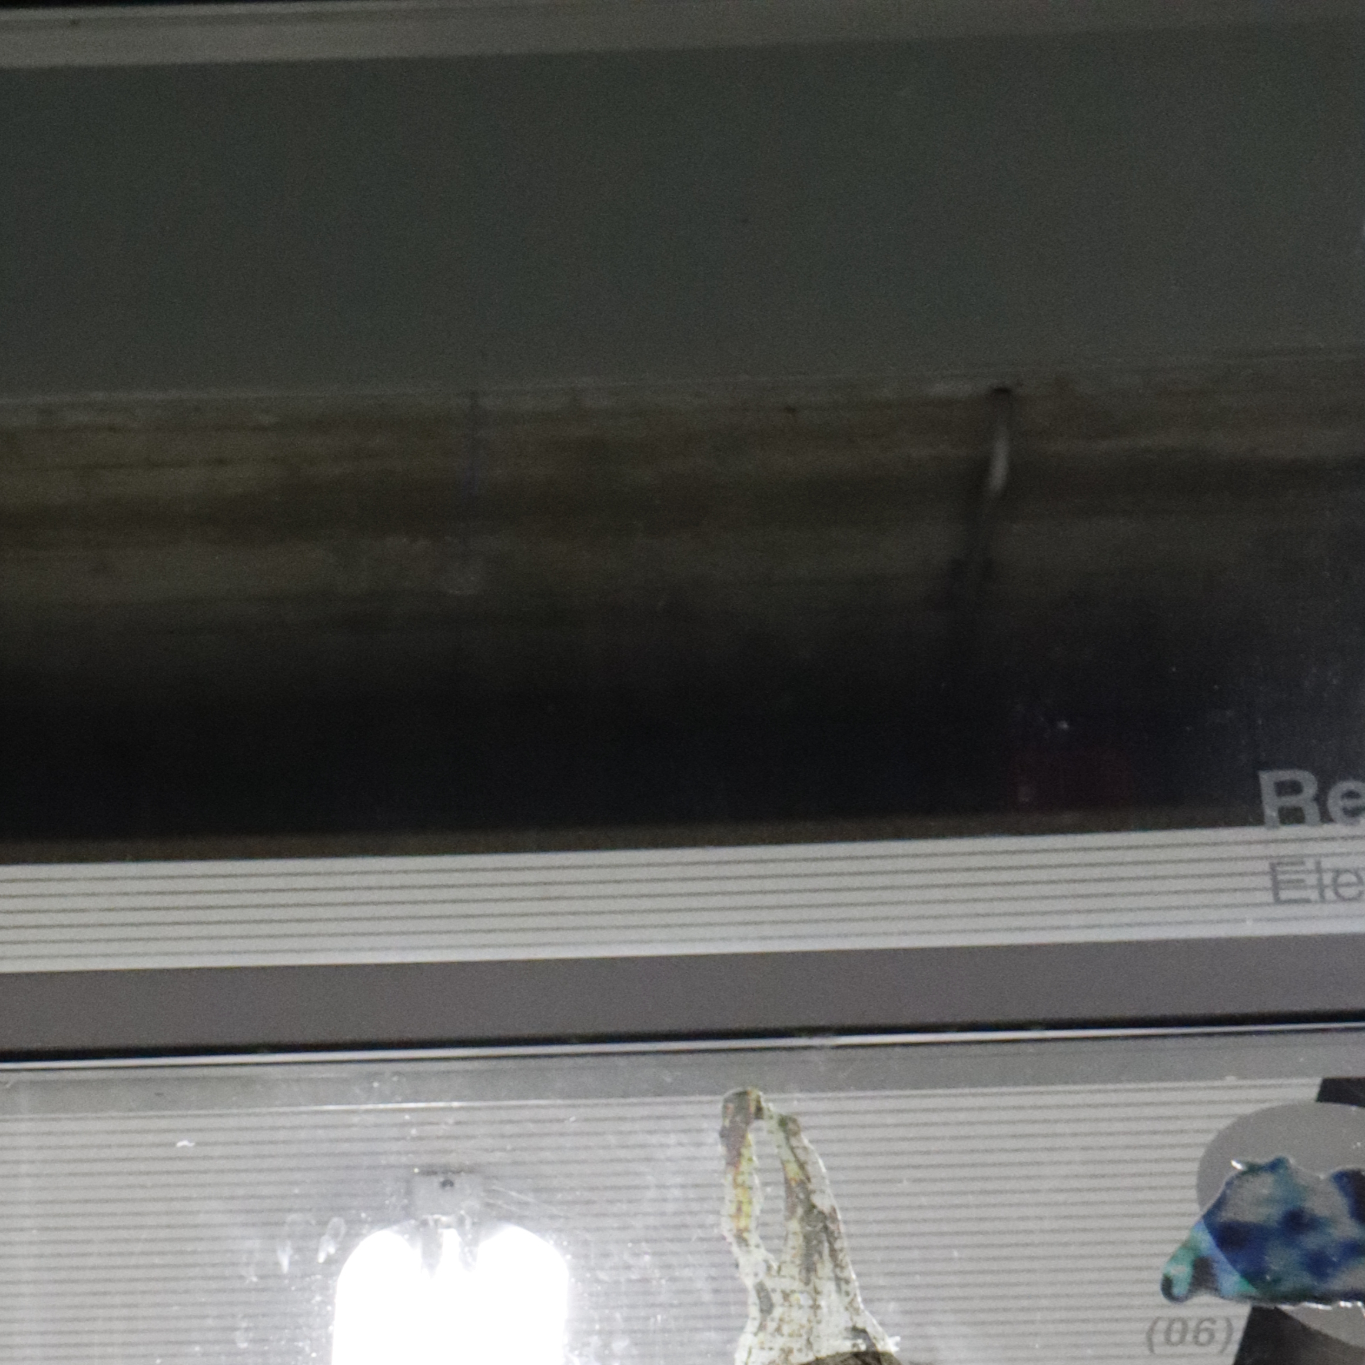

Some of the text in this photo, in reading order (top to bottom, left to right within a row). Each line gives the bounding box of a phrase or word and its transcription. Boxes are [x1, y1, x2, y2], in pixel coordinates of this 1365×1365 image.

[1258, 768, 1365, 831] Re
[1268, 857, 1365, 904] Ele
[1144, 1315, 1236, 1355] (06)
